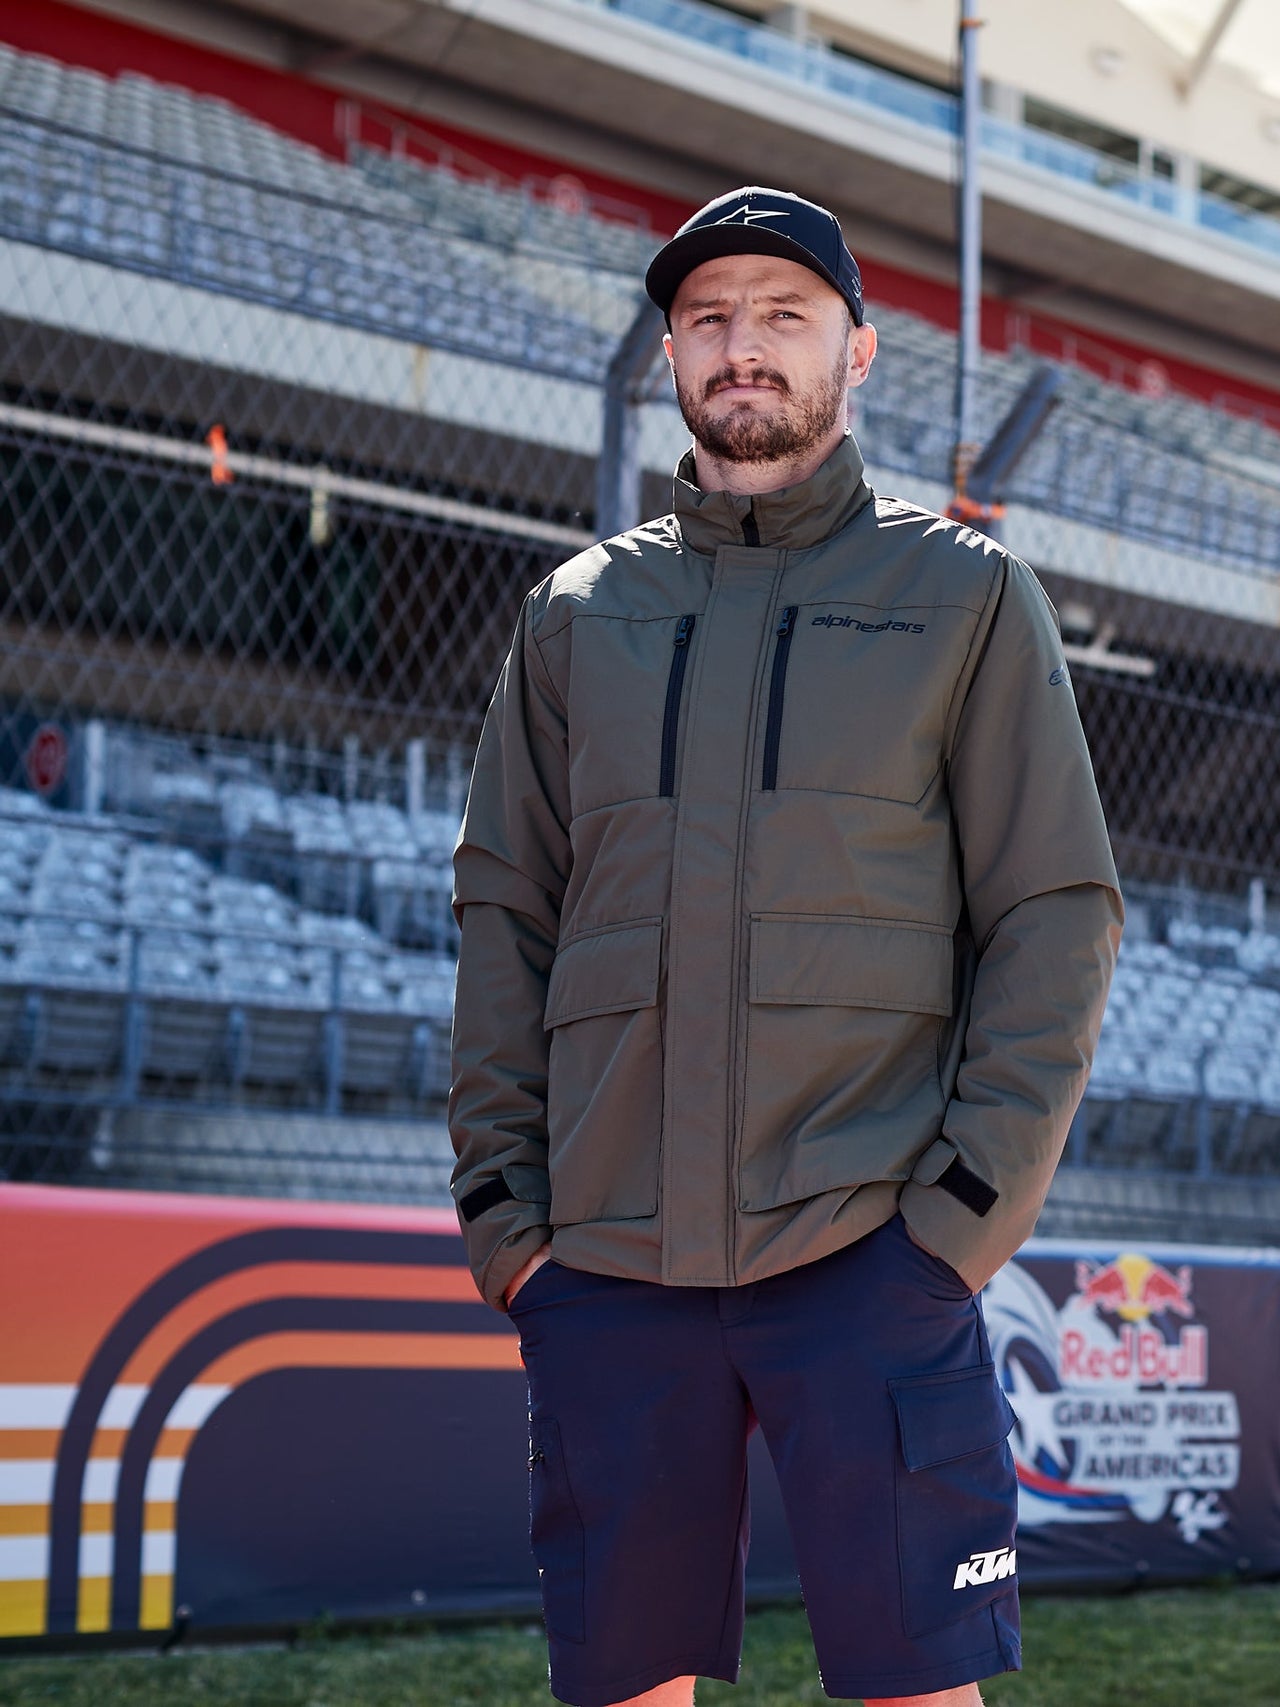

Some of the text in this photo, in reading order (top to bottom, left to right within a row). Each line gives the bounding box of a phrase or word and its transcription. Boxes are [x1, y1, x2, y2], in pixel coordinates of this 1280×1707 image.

[811, 614, 926, 634] alpinestars
[1061, 1325, 1207, 1384] Red Bull
[1053, 1400, 1230, 1427] GRAND PRIX
[1084, 1452, 1228, 1480] AMERICAS
[953, 1546, 1017, 1590] KTM
